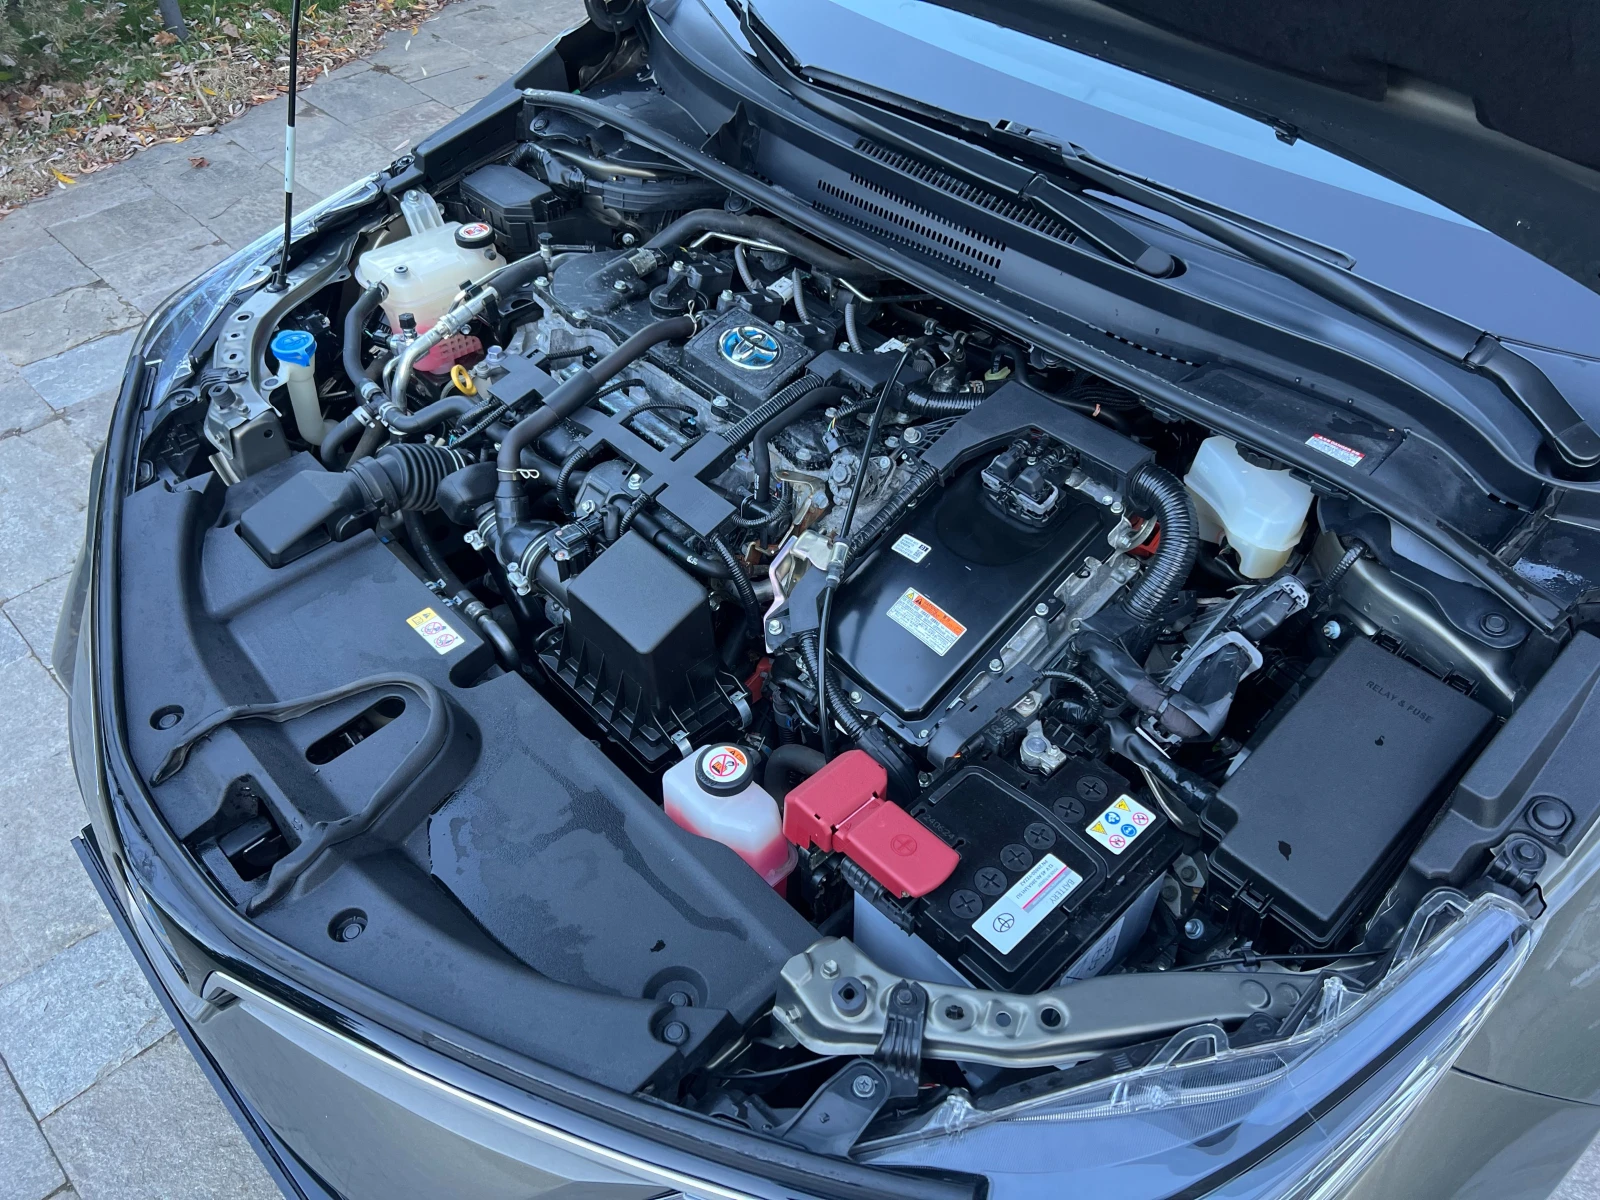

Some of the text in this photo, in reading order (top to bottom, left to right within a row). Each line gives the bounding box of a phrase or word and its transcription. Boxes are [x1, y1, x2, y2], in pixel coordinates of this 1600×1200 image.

[1366, 681, 1397, 701] RELAY
[1407, 705, 1433, 723] FUSE
[1050, 878, 1074, 904] BATTERY
